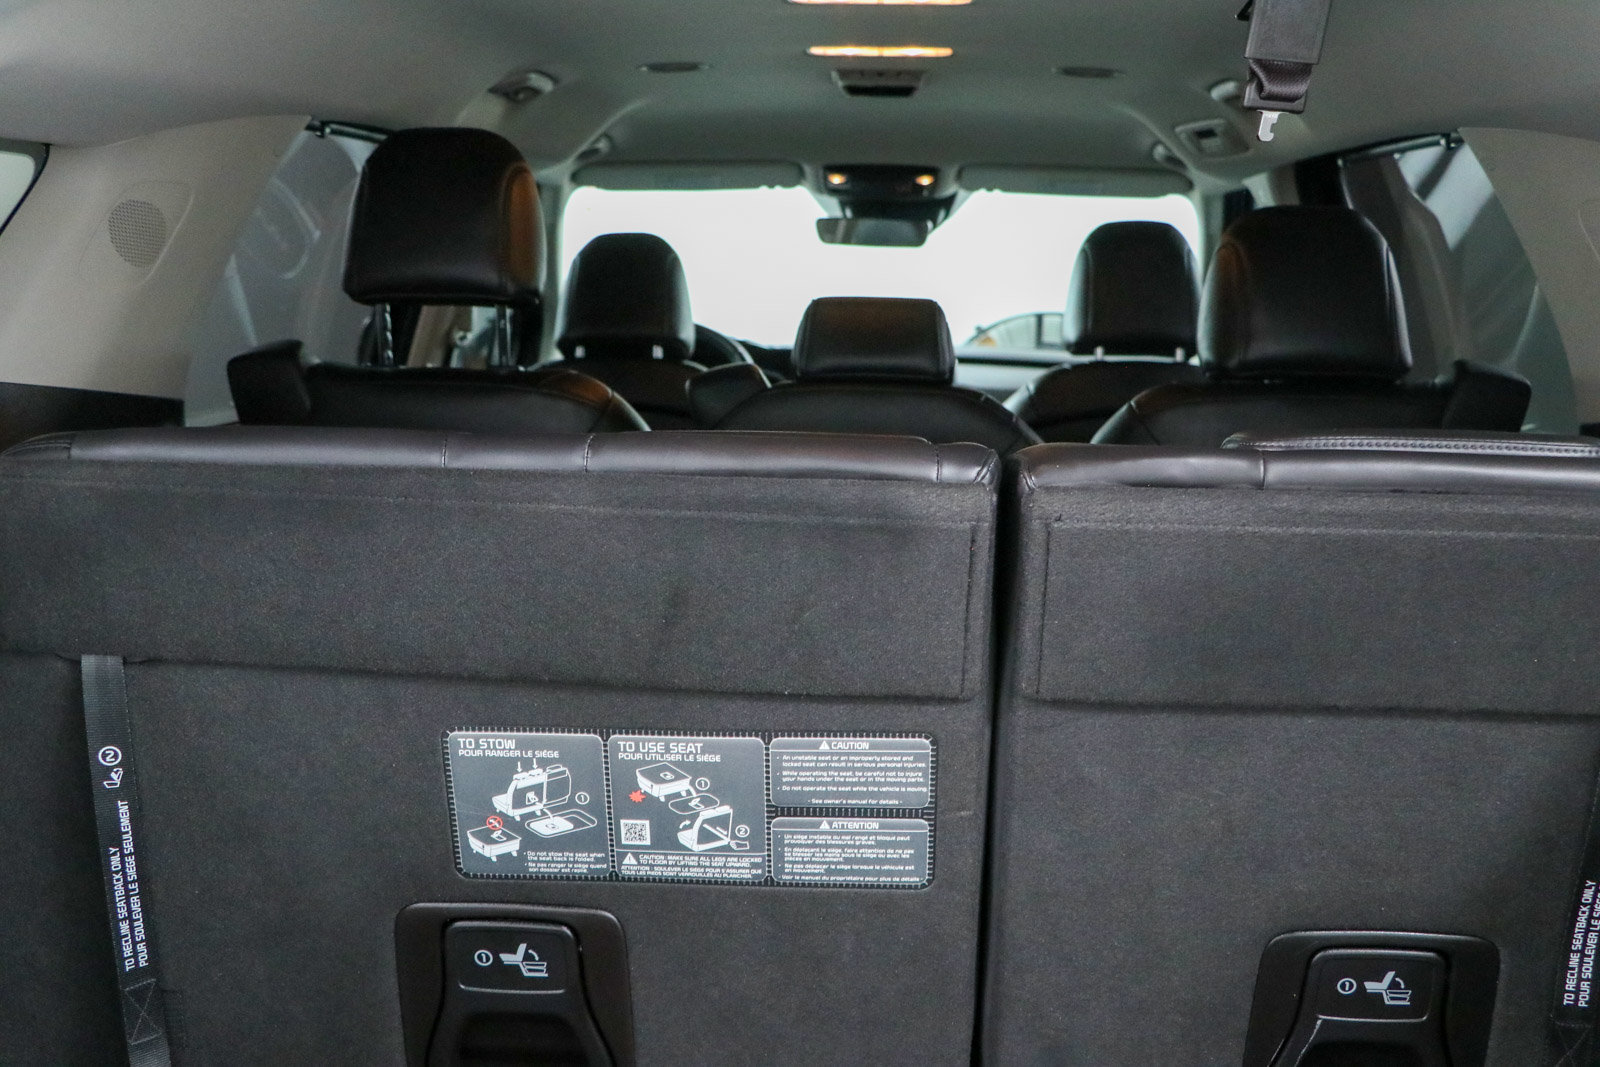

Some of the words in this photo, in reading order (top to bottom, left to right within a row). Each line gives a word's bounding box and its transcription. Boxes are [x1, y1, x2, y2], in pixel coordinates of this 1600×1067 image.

[457, 738, 474, 748] TO
[479, 739, 515, 749] STOW
[618, 742, 634, 752] TO
[640, 742, 665, 752] USE
[670, 743, 703, 753] SEAT
[832, 742, 869, 750] CAUTION
[118, 800, 134, 854] SEULEMENT
[832, 821, 879, 829] ATTENTION
[109, 847, 121, 871] ONLY
[112, 872, 128, 919] SEATBACK
[129, 882, 139, 895] LE
[1582, 880, 1596, 903] ONLY
[130, 896, 145, 941] SOULEVER
[1572, 905, 1590, 950] SEATBACK
[1590, 919, 1600, 931] LE
[120, 920, 133, 957] RECLINE
[125, 958, 135, 972] TO
[137, 942, 148, 967] POUR
[1582, 932, 1598, 979] SOULEVER
[1566, 952, 1580, 991] RECLINE
[1564, 993, 1575, 1006] TO
[1578, 981, 1590, 1007] POUR
